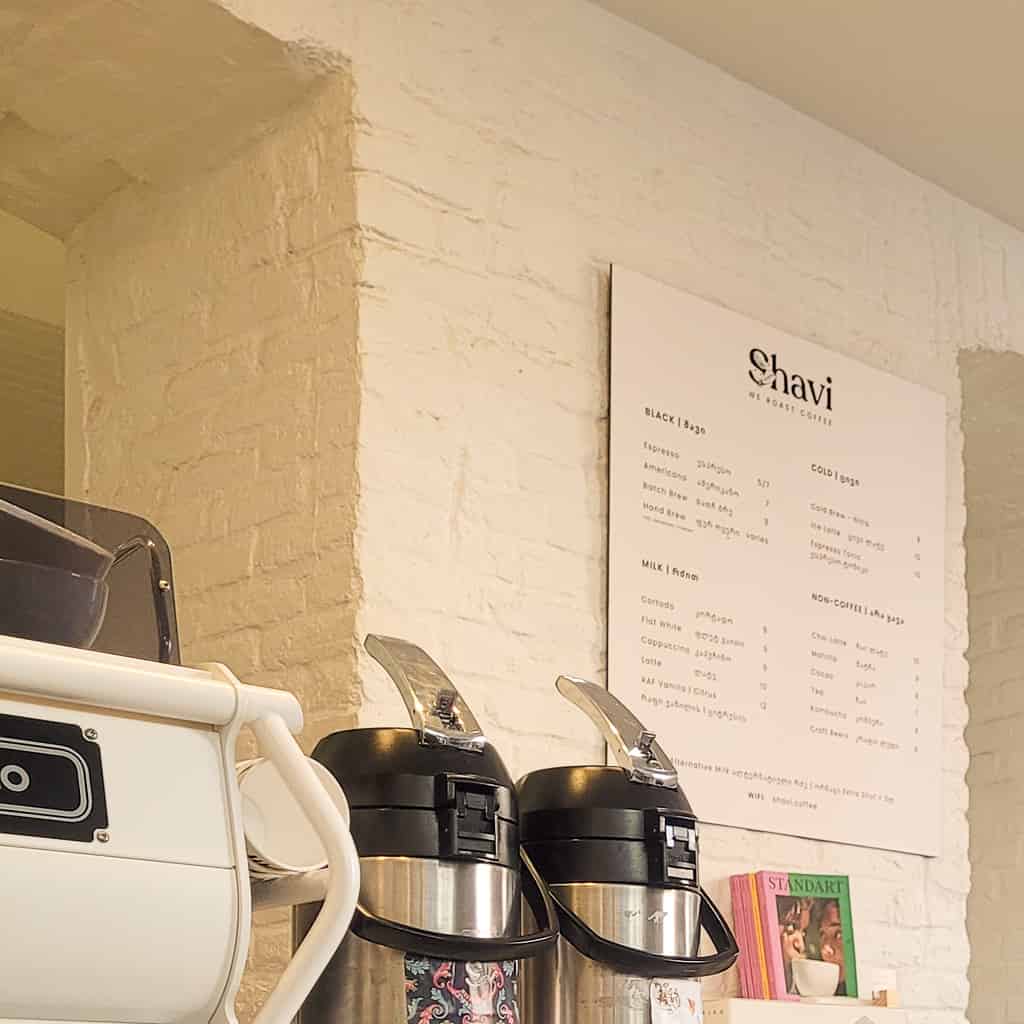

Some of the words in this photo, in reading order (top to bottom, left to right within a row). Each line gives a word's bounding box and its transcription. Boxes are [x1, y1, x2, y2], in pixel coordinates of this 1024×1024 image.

[749, 348, 832, 411] Shavi
[645, 407, 675, 424] BLACK
[643, 441, 680, 459] Espresso
[811, 463, 832, 477] COLD
[768, 876, 843, 894] STANDART
